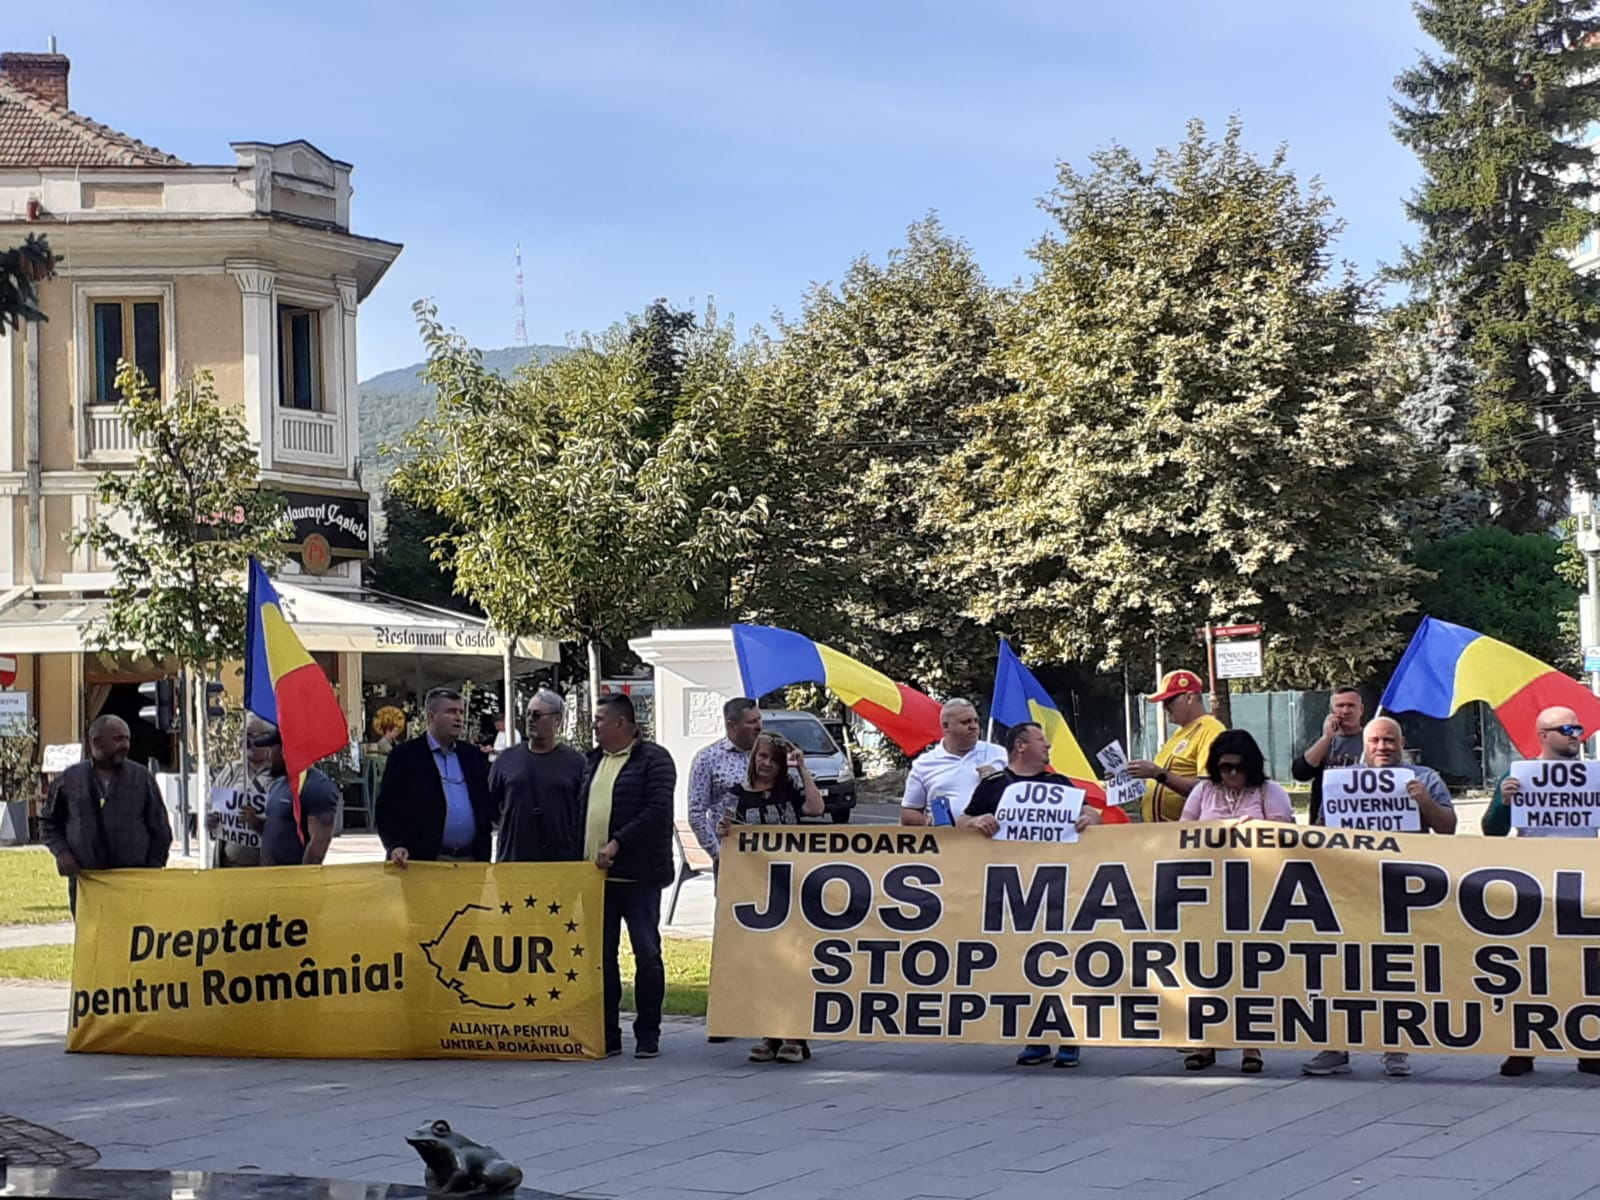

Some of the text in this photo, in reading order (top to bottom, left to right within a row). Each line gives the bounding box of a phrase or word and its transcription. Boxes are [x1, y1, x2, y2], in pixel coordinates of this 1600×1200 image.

[279, 503, 325, 525] staurant
[373, 627, 496, 648] Restaurant Castelo
[1343, 769, 1395, 794] JOS
[1532, 763, 1587, 787] JOS
[1016, 783, 1064, 805] JOS
[997, 808, 1076, 824] GUVERNUL
[1327, 797, 1416, 814] GUVERNUL
[1341, 816, 1403, 831] MAFIOT
[1528, 811, 1592, 827] MAFIOT
[738, 832, 939, 855] HUNEDOARA
[1007, 825, 1064, 842] MAFIOT
[1179, 827, 1401, 853] HUNEDOARA
[733, 862, 944, 932] JOS
[982, 860, 1343, 934] MAFIA
[130, 914, 308, 967] Dreptate
[459, 935, 555, 974] AUR
[810, 938, 998, 987] STOP
[73, 952, 405, 1027] pentru România!
[514, 1024, 569, 1037] PENTRU
[811, 990, 1161, 1040] DREPTATE
[1186, 994, 1483, 1049] PENTRU
[440, 1038, 584, 1055] UNIREA ROMÂNILOR
